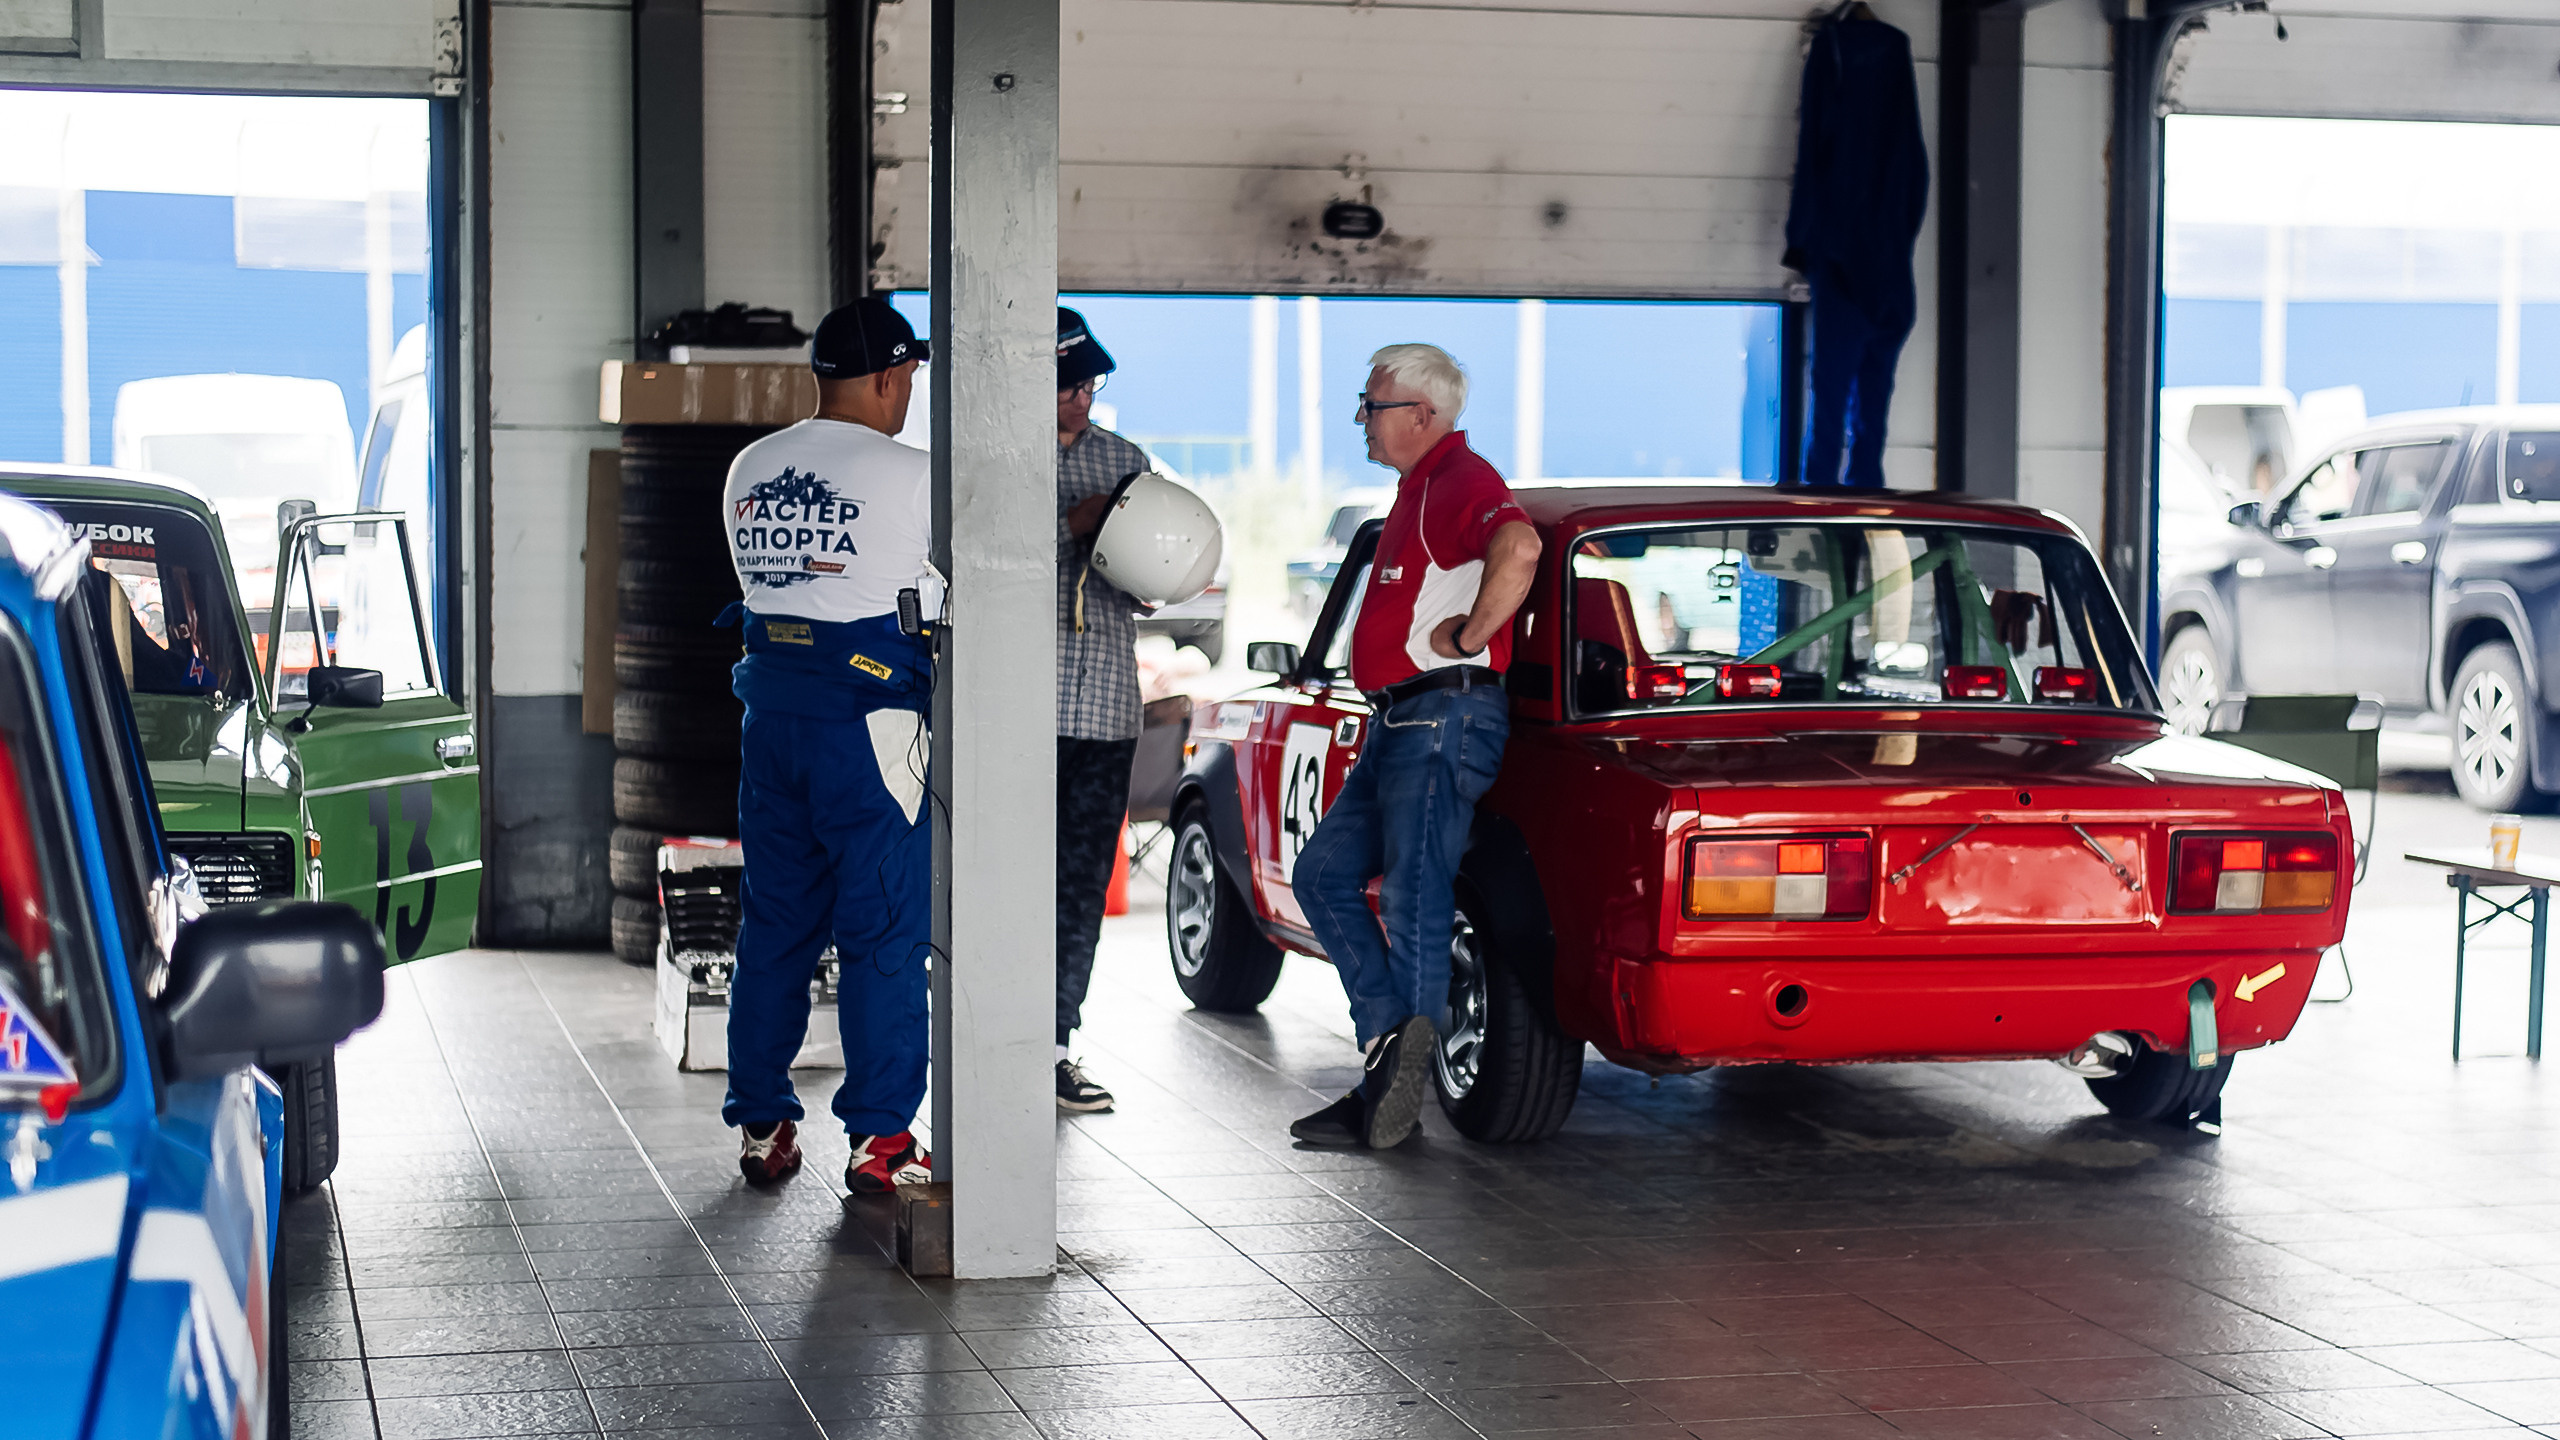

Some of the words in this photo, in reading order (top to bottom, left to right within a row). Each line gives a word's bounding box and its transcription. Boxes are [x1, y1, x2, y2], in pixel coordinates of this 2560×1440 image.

[734, 497, 860, 525] МАСТЕР
[736, 527, 858, 556] СПОРТА
[746, 556, 797, 567] КАРТИНГУ
[765, 573, 787, 583] 2019
[1284, 752, 1320, 856] 43
[369, 782, 437, 961] 13
